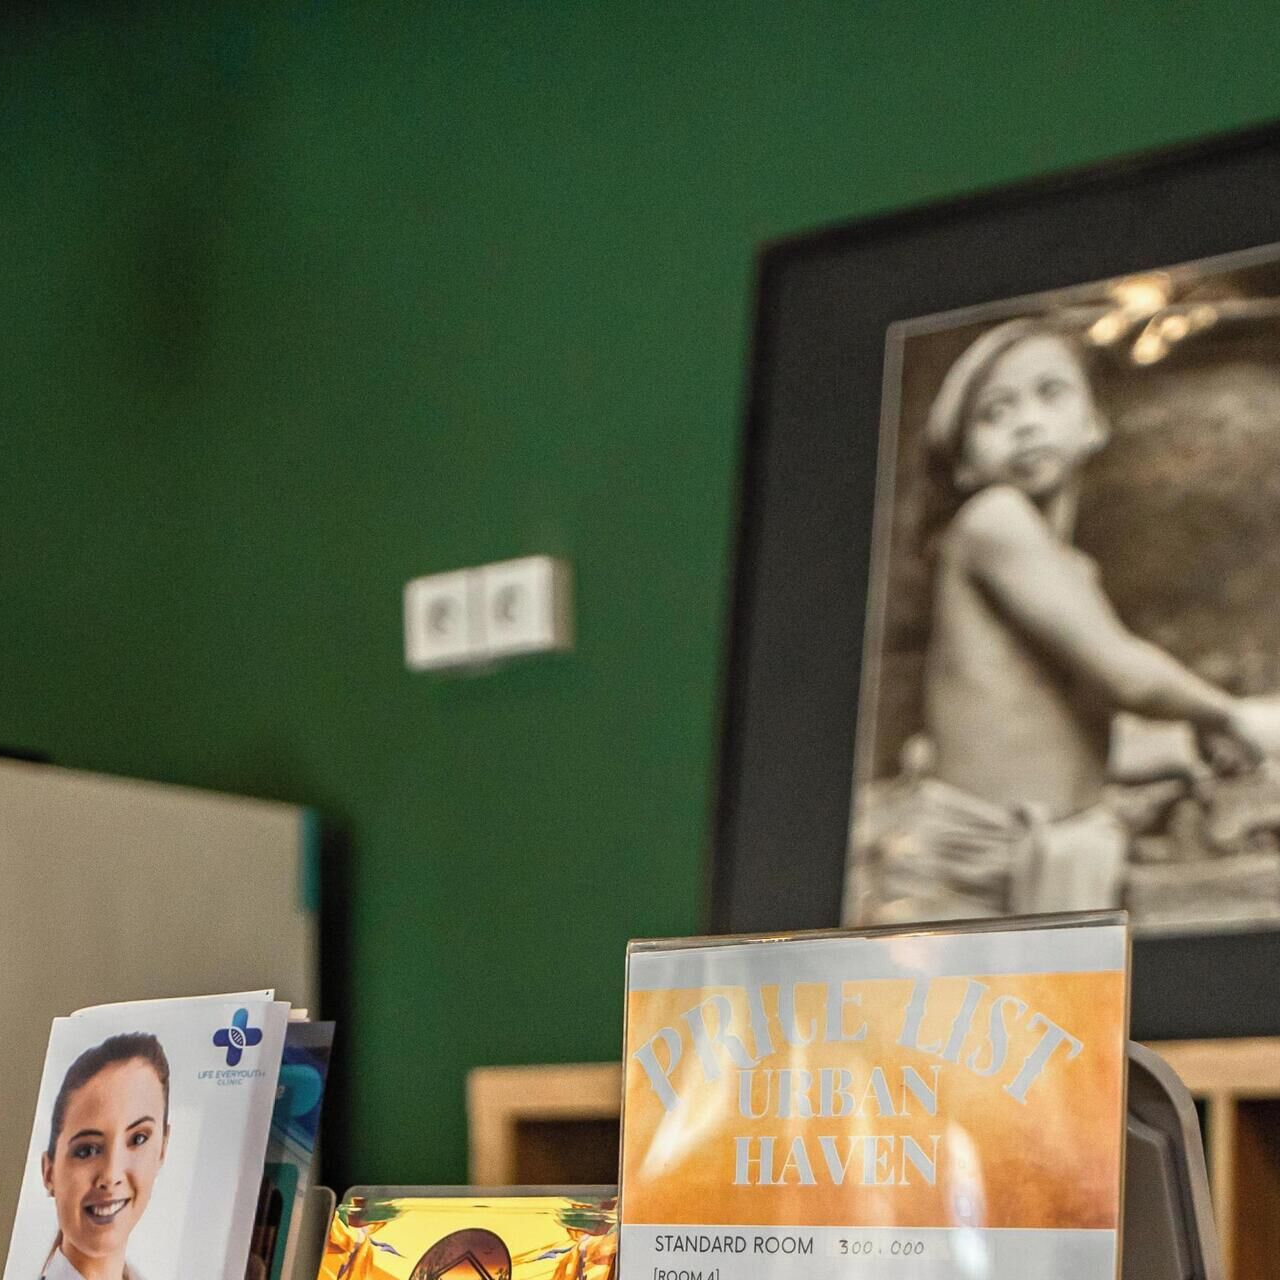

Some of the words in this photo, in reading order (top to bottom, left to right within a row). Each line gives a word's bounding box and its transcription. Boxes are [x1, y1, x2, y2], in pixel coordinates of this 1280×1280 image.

[633, 982, 867, 1111] PRICE
[896, 977, 1084, 1105] LIST
[198, 1070, 214, 1079] LIFE
[738, 1065, 941, 1119] URBAN
[732, 1135, 941, 1186] HAVEN
[655, 1235, 746, 1253] STANDARD
[753, 1236, 813, 1254] ROOM
